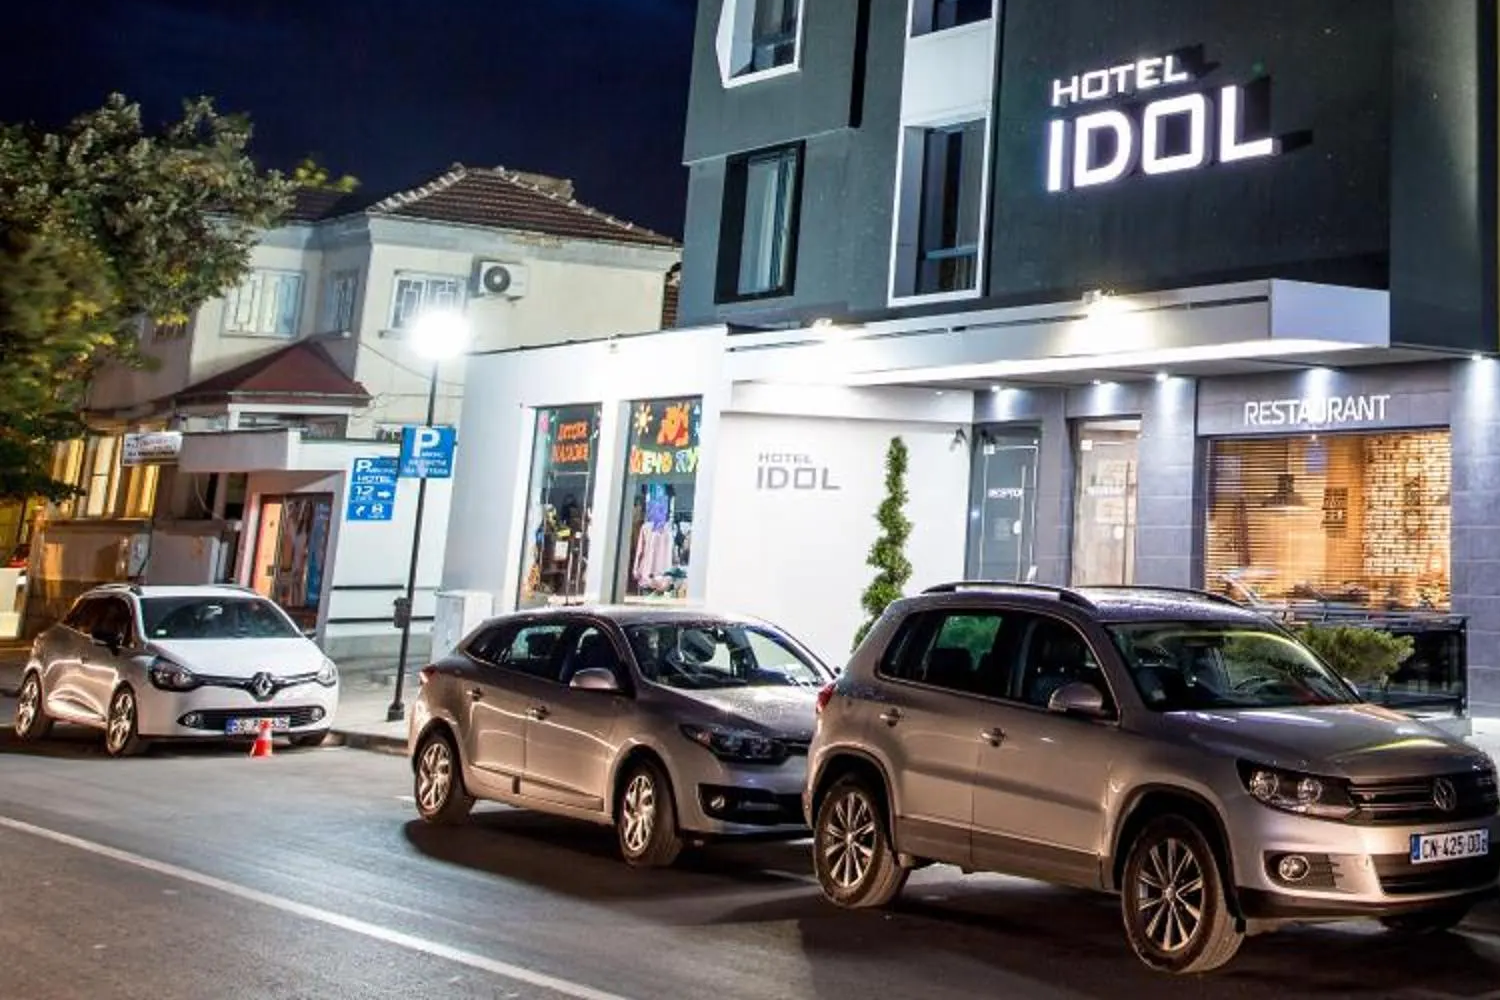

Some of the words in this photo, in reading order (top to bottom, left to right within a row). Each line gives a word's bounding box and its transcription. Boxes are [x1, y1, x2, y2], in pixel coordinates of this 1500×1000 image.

[1052, 54, 1189, 108] HOTEL
[1047, 84, 1274, 193] IDOL
[1244, 394, 1391, 426] RESTAURANT
[758, 452, 814, 464] HOTEL
[757, 466, 842, 490] IDOL
